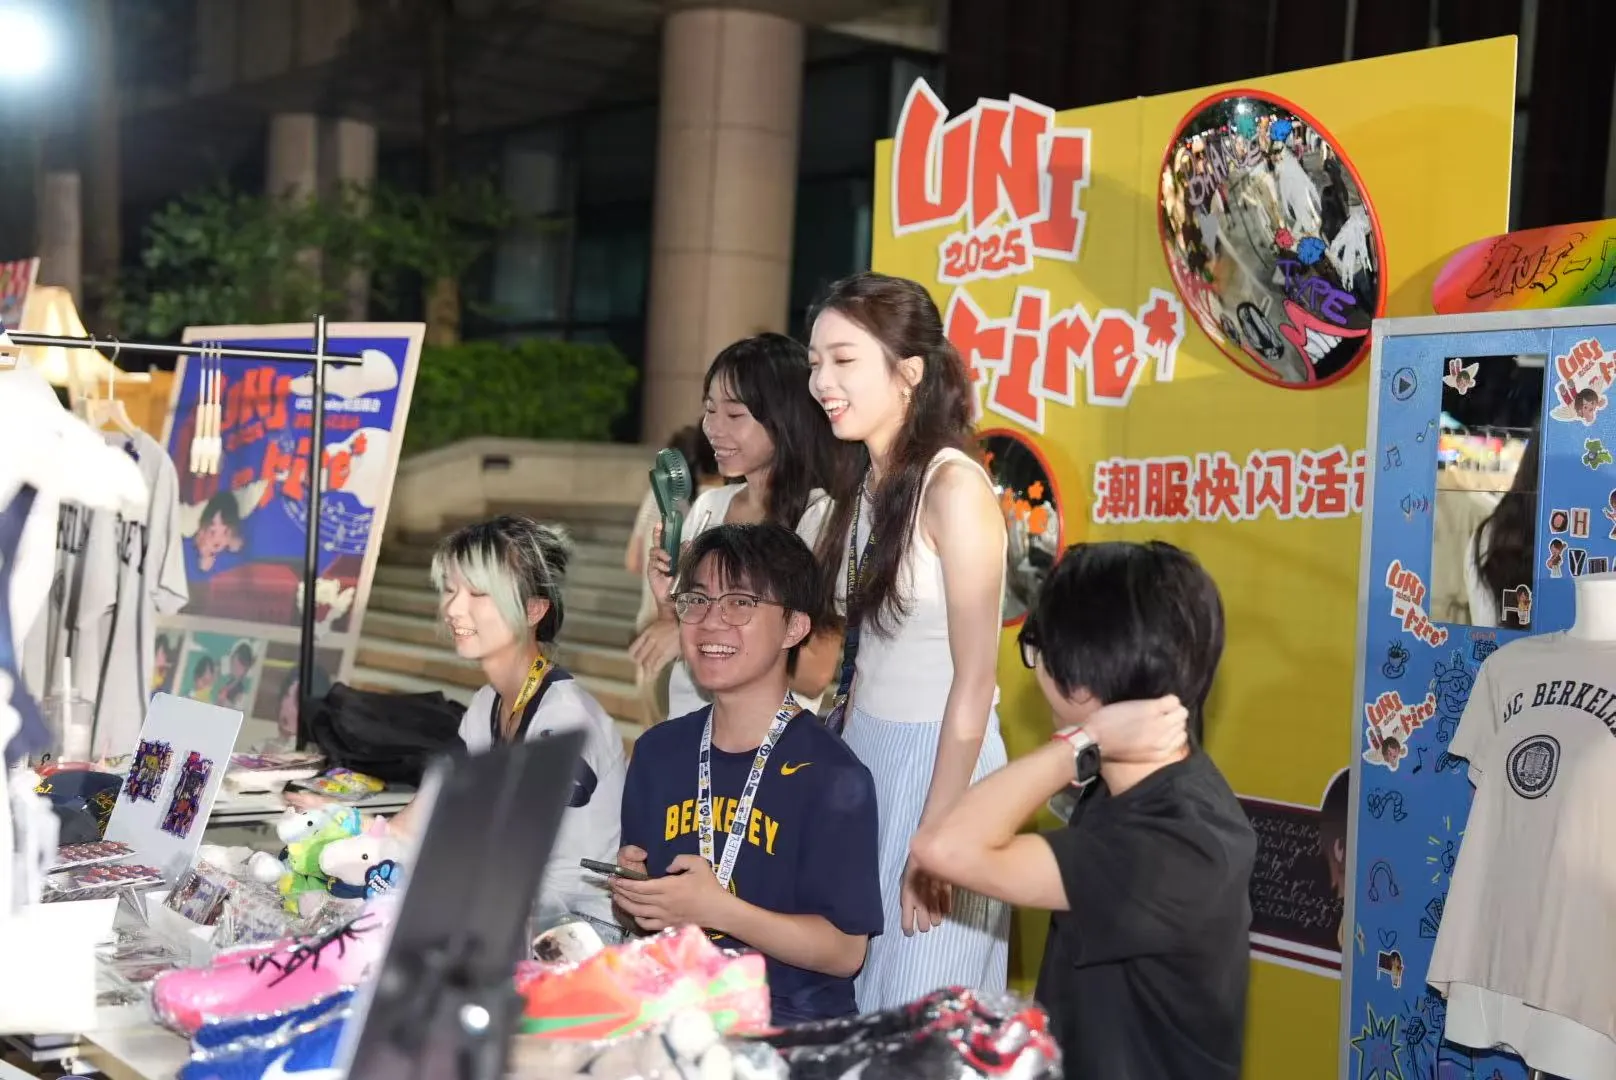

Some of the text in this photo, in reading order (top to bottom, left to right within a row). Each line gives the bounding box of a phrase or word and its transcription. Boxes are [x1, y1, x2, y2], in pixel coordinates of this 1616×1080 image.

[895, 79, 1089, 258] UNI
[942, 228, 1027, 278] 2025
[1276, 258, 1357, 325] TYPE
[1557, 339, 1604, 381] UNI
[258, 436, 352, 508] Fie
[1530, 680, 1616, 738] BERKELE
[664, 796, 779, 855] BEKEEY
[718, 836, 742, 881] BERKELEY
